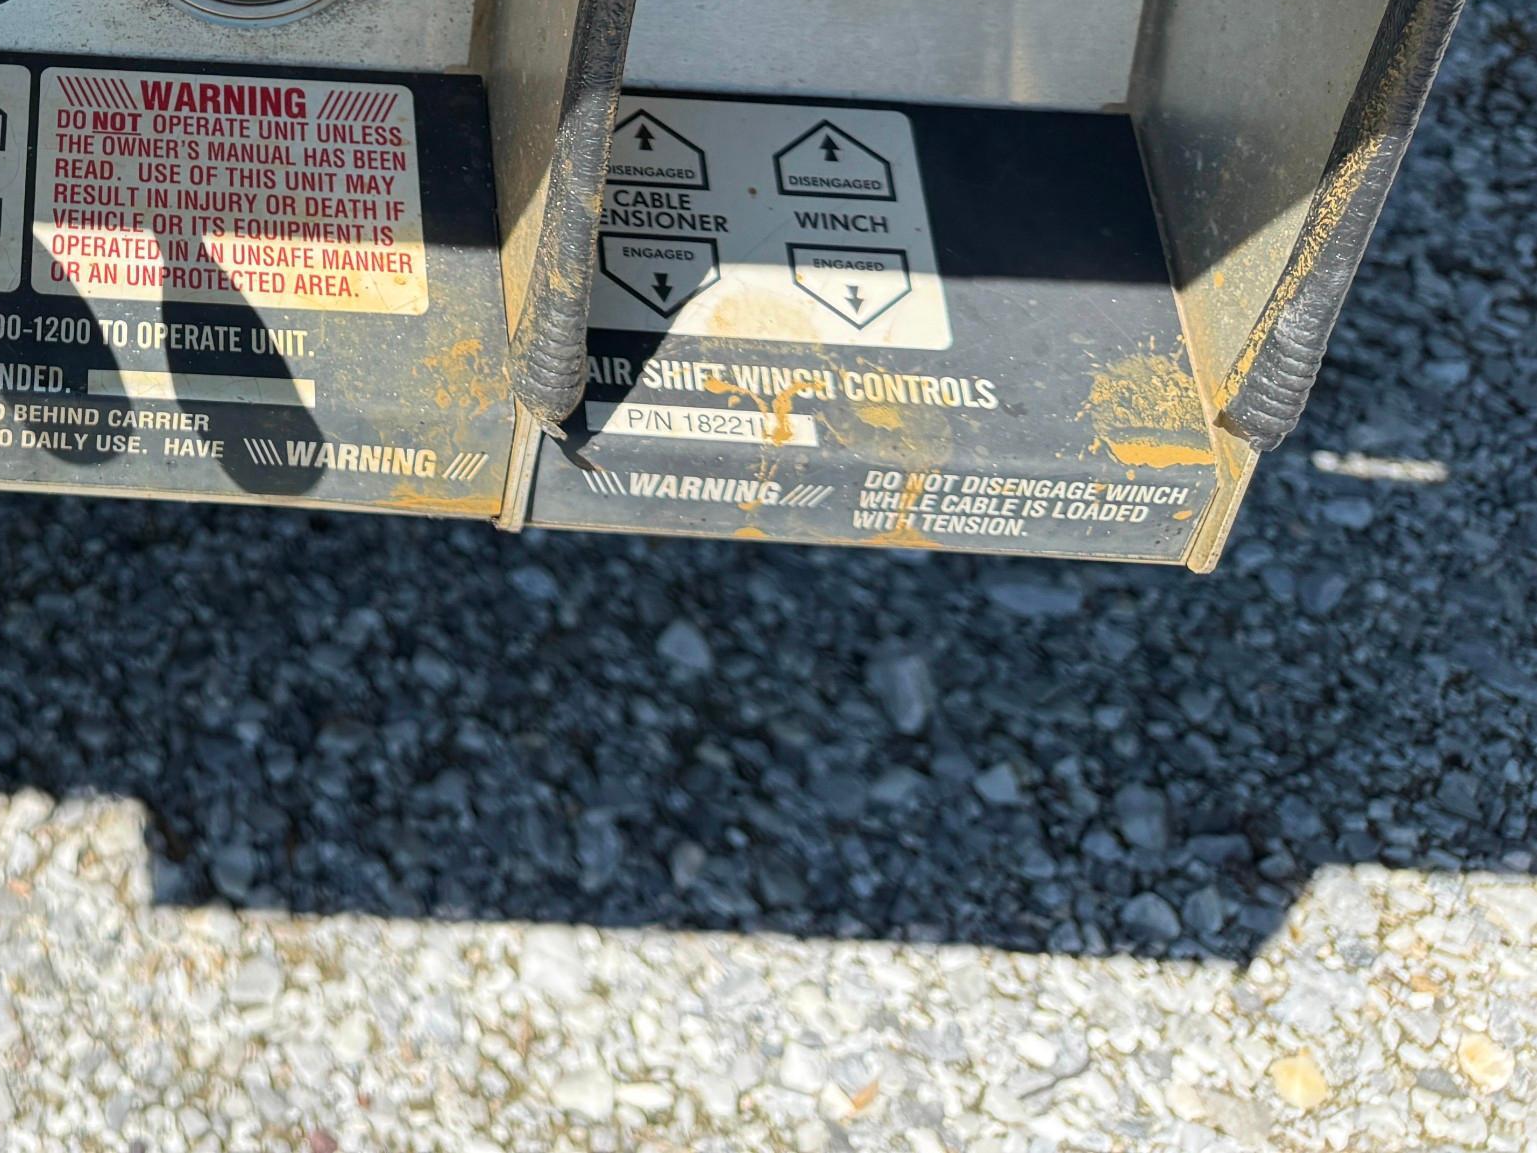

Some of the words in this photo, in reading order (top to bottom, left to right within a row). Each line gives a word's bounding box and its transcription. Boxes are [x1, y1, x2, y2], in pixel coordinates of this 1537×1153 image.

[139, 79, 307, 119] WARNING
[57, 109, 86, 130] DO
[92, 112, 143, 135] NOT
[152, 114, 251, 139] OPERATE
[258, 119, 309, 141] UNIT
[316, 123, 402, 147] UNLESS
[56, 133, 94, 155] THE
[101, 135, 200, 161] OWNER'S
[207, 141, 297, 167] MANUAL
[303, 146, 346, 169] HAS
[352, 148, 407, 172] BEEN
[54, 159, 122, 181] READ.
[138, 161, 182, 185] USE
[189, 164, 218, 186] OF
[225, 167, 277, 190] THIS
[285, 170, 337, 193] UNIT
[345, 174, 395, 196] MAY
[788, 175, 883, 192] DISENGAGED
[53, 183, 140, 208] RESULT
[146, 188, 169, 209] IN
[177, 189, 258, 214] INJURY
[265, 193, 297, 216] OR
[305, 196, 378, 221] DEATH
[385, 200, 406, 222] IF
[614, 189, 692, 211] CABLE
[52, 208, 145, 234] VEHICLE
[152, 213, 184, 236] OR
[191, 216, 226, 239] ITS
[233, 218, 365, 245] EQUIPMENT
[372, 224, 395, 247] IS
[599, 208, 729, 233] ENSIONER
[794, 211, 890, 234] WINCH
[51, 234, 161, 261] OPERATED
[168, 240, 189, 262] IN
[195, 242, 224, 265] AN
[232, 244, 315, 270] UNSAFE
[321, 249, 414, 275] MANNER
[622, 246, 695, 261] ENGAGED
[812, 258, 886, 273] ENGAGED
[50, 260, 80, 283] OR
[87, 261, 118, 285] AN
[126, 264, 286, 295] UNPROTECTED
[293, 273, 360, 298] AREA.
[100, 320, 128, 347] TO
[137, 321, 242, 353] OPERATE
[251, 327, 315, 358] UNIT.
[587, 356, 634, 386] AIR
[642, 359, 727, 392] SHIFT
[731, 364, 837, 401] WINCH
[843, 370, 1000, 411] CONTROLS
[13, 404, 100, 427] BEHIND
[108, 408, 211, 432] CARRIER
[627, 408, 673, 431] P/N
[21, 430, 88, 452] DAILY
[96, 435, 148, 455] USE.
[163, 437, 225, 459] HAVE
[285, 439, 437, 479] WARNING
[629, 471, 783, 506] WARNING
[864, 470, 903, 490] DO
[905, 473, 961, 494] NOT
[961, 475, 1098, 502] DISENGAGE
[1105, 484, 1190, 506] WINCH
[852, 509, 917, 531] WITH
[921, 513, 1030, 538] TENSION.
[858, 490, 939, 513] WHILE
[940, 494, 1017, 518] CABLE
[1021, 499, 1049, 519] IS
[1052, 502, 1150, 524] LOADED
